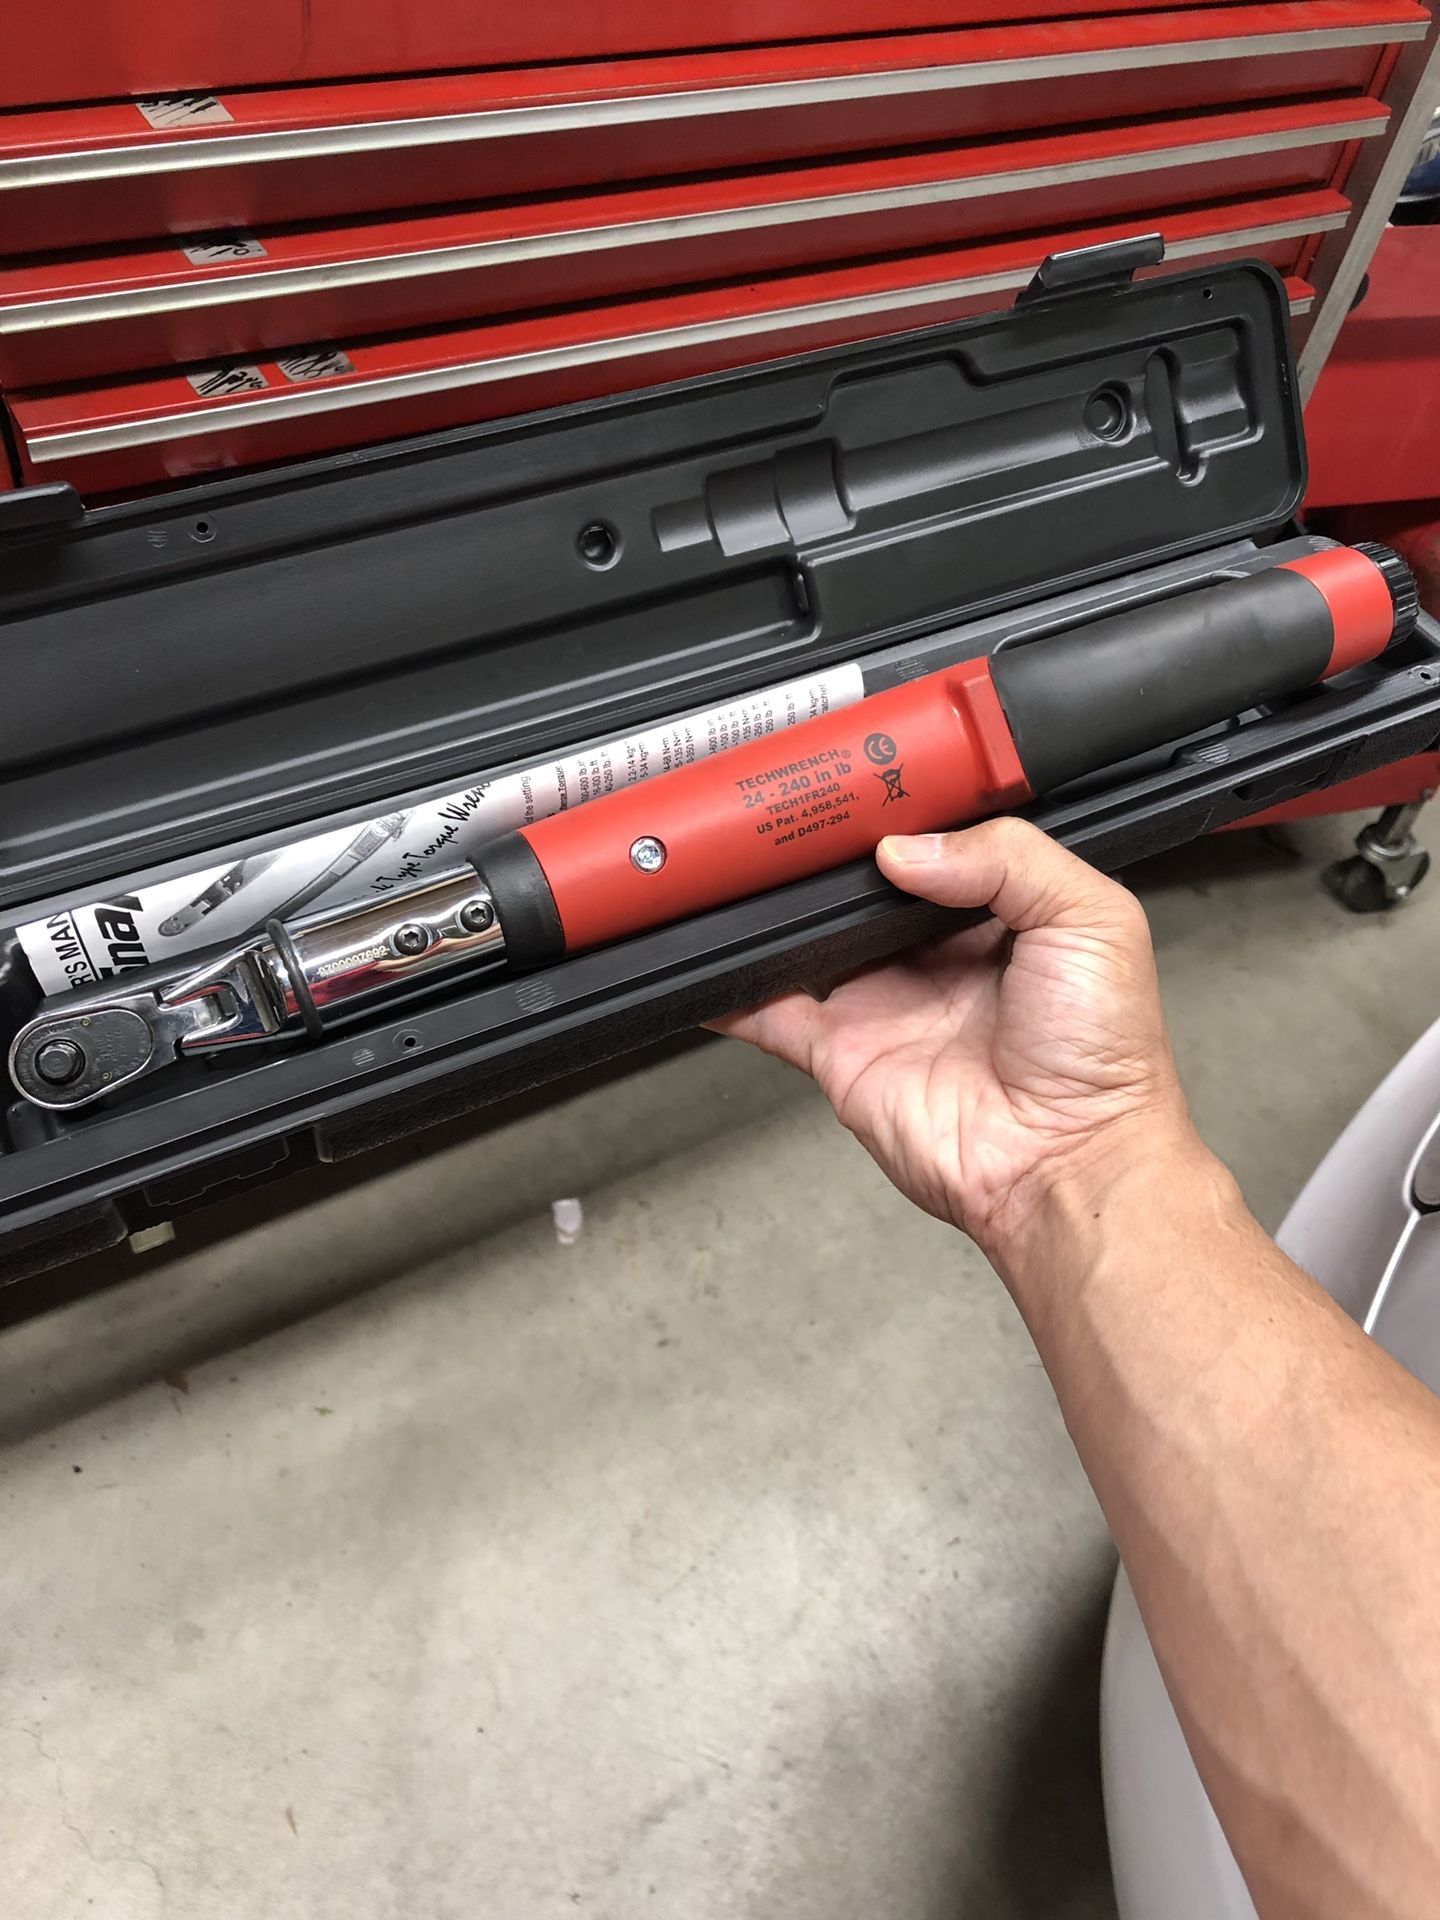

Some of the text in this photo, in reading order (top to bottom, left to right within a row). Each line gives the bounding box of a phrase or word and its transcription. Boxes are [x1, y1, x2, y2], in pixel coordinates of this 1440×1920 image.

[520, 775, 534, 804] setting
[742, 790, 765, 809] 24
[778, 775, 811, 797] 240
[814, 770, 832, 783] in
[834, 762, 852, 777] lb
[766, 782, 841, 816] TECH1FR240
[756, 821, 774, 834] US
[775, 814, 799, 828] Pat.
[773, 810, 850, 846] and D497-294
[401, 825, 459, 860] Torque
